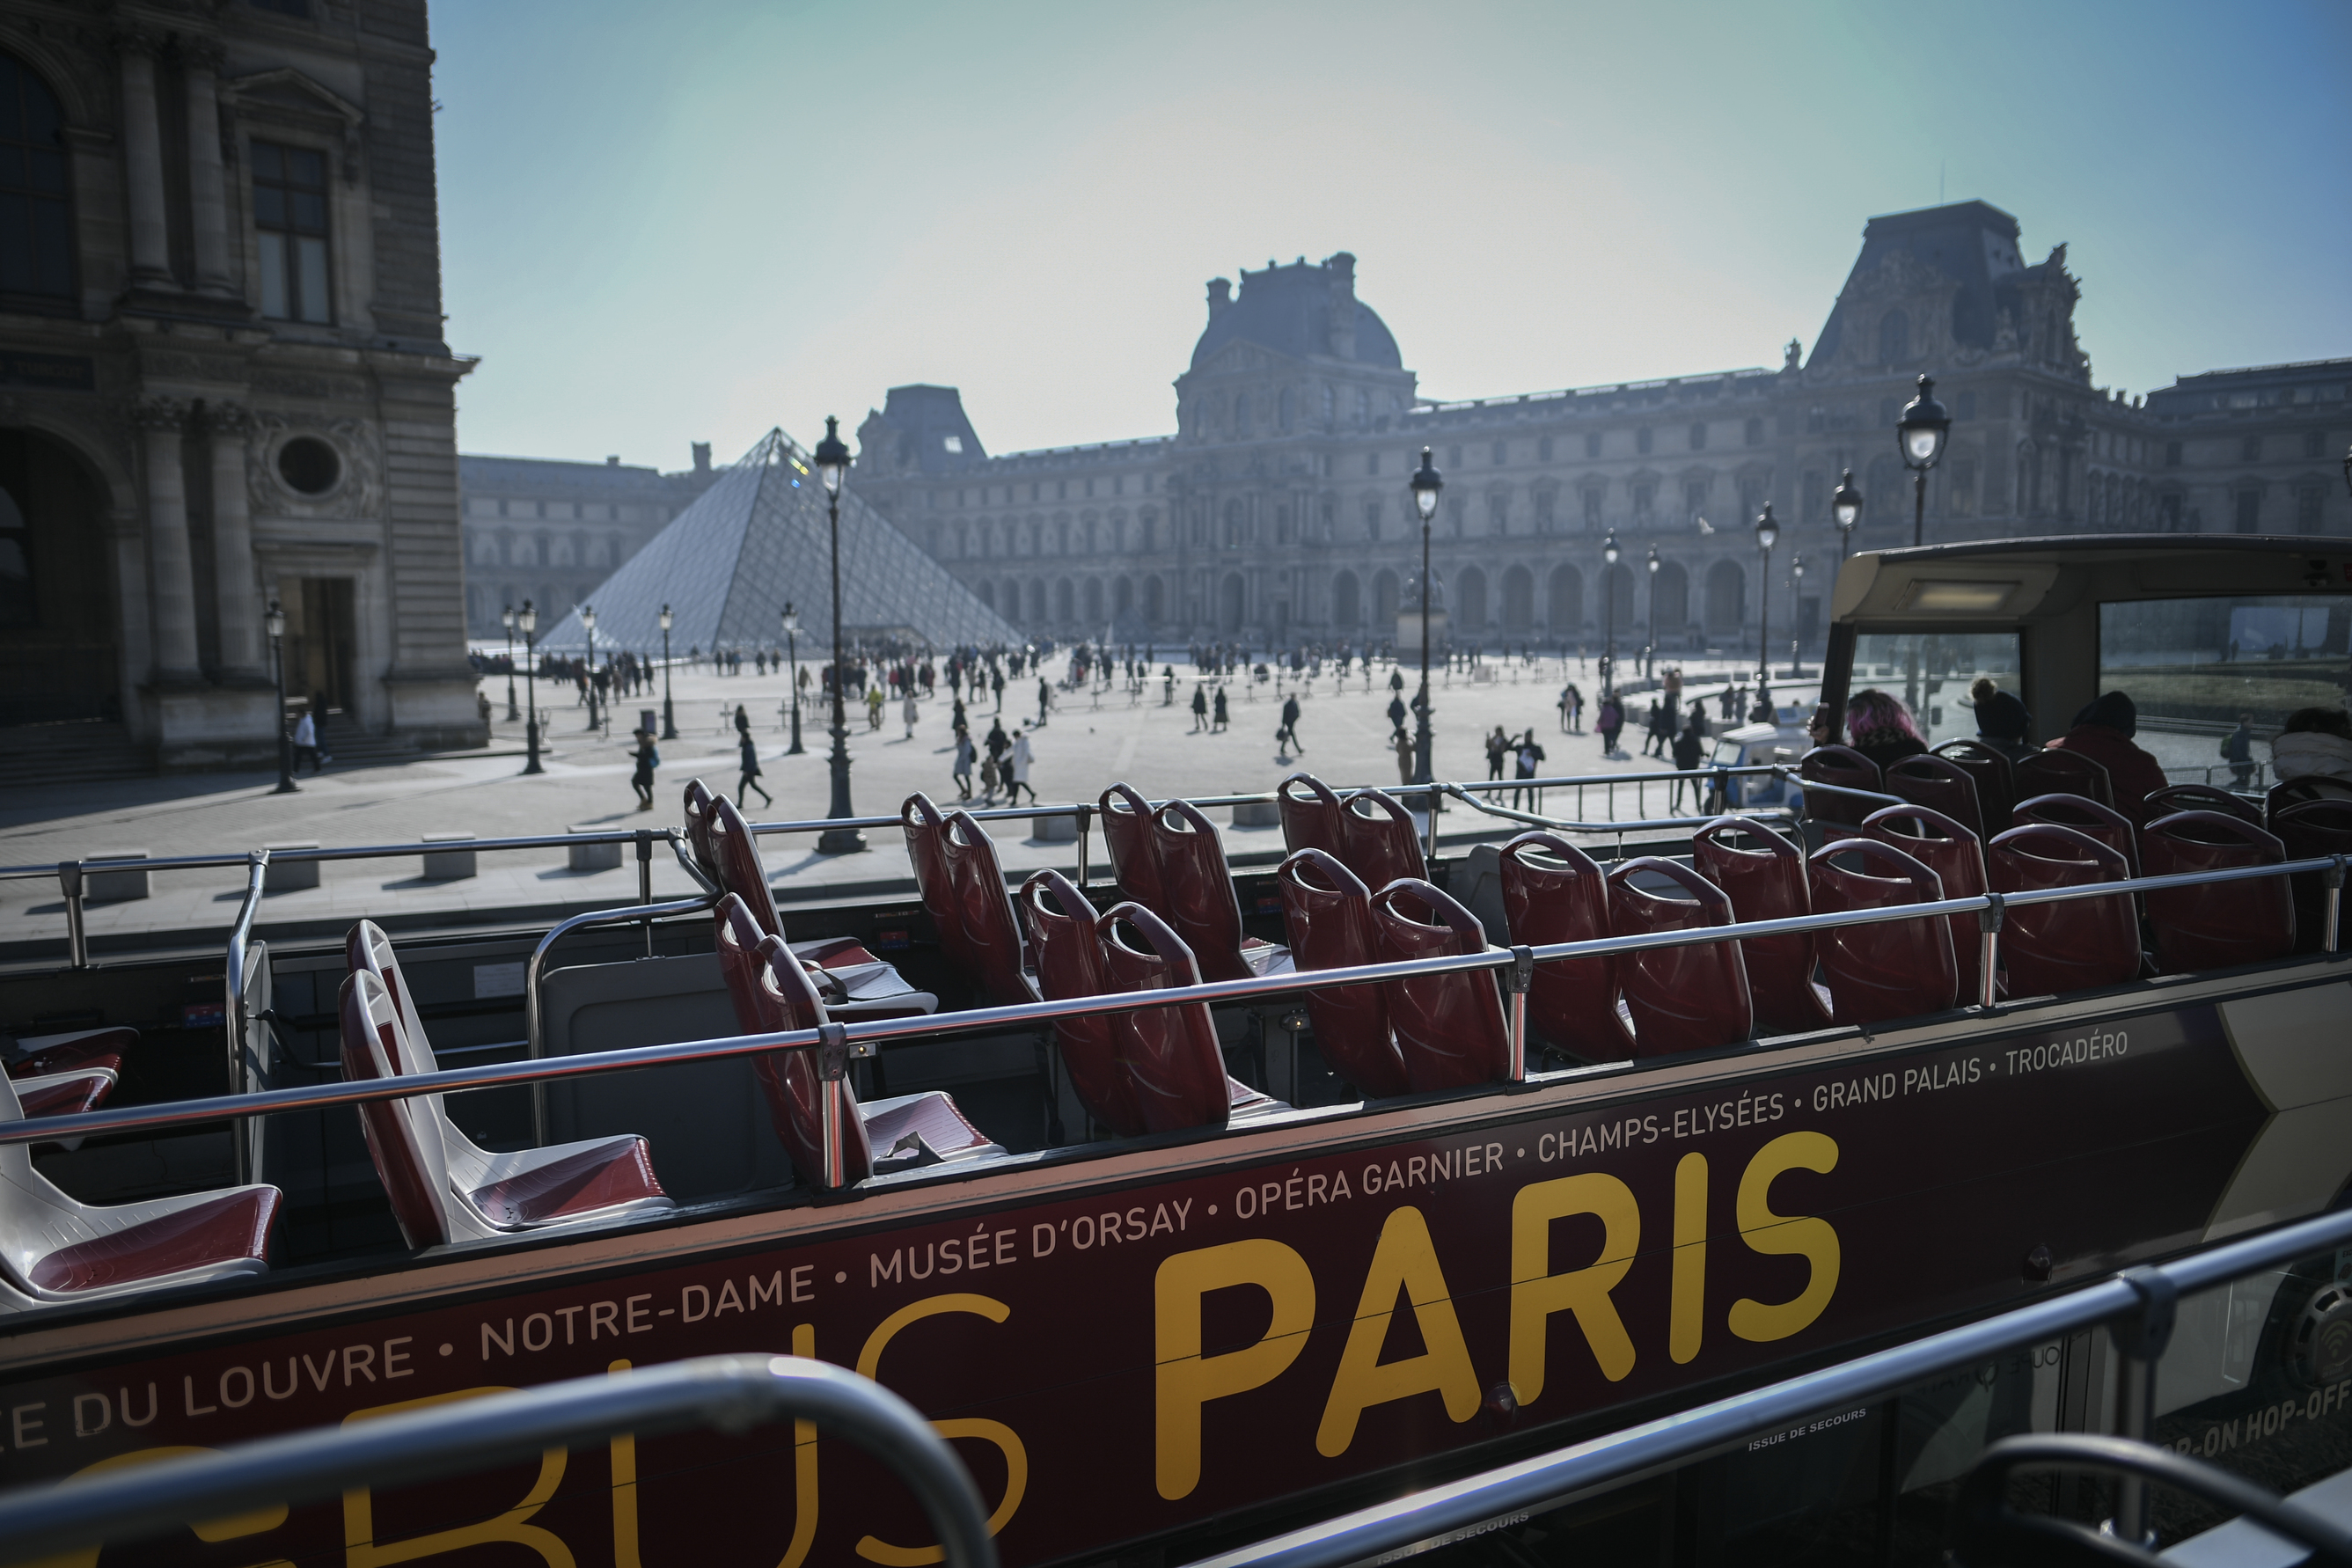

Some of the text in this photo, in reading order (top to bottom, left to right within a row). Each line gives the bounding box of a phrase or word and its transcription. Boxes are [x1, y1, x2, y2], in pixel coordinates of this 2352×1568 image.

[0, 1029, 2129, 1452] E DU LOUVRE NOTRE-DAME MUSÉE D'ORSAY OPÉRA GARNIER CHAMPS-ELYSÉES GRAND PALAIS TROCADÉRO
[1154, 1130, 1841, 1501] PARIS
[1748, 1408, 1867, 1452] ISSUE DE SECOURS
[2246, 1379, 2352, 1443] HOP-OFF
[1377, 1512, 1529, 1566] ISSUE DE SECOURS
